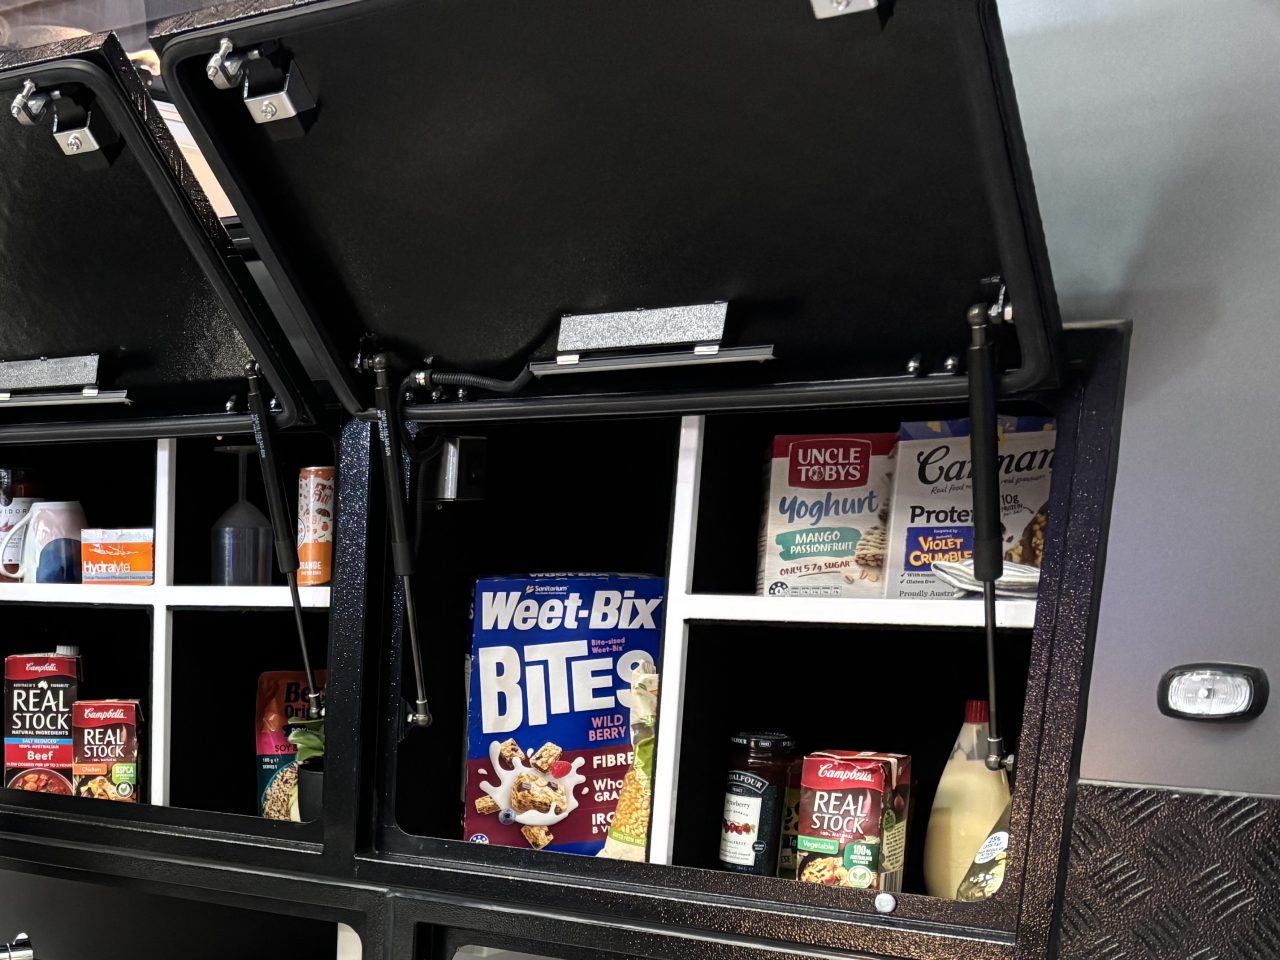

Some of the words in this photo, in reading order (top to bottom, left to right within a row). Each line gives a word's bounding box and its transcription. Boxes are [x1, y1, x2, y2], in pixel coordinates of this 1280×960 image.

[798, 448, 861, 464] UNCLE
[797, 464, 861, 482] TOBYS
[1001, 494, 1019, 504] 10g
[795, 530, 840, 544] MANGO
[918, 536, 963, 551] VIOLET
[790, 541, 853, 554] PASSIONFRUIT
[909, 550, 973, 567] CRUMBLE
[83, 560, 131, 575] Hydralyte
[780, 566, 802, 576] ONLY
[824, 560, 850, 569] SUGAR
[900, 590, 928, 598] Proudly
[482, 590, 661, 630] Weet-Bix
[591, 637, 626, 646] Bite-sized
[591, 645, 623, 654] Weet-Bix
[13, 689, 70, 711] REAL
[12, 713, 69, 730] STOCK
[591, 714, 624, 729] WILD
[84, 728, 124, 745] REAL
[589, 726, 627, 742] BERRY
[27, 750, 54, 761] Beef
[84, 745, 124, 757] STOCK
[275, 744, 290, 752] SOY
[593, 751, 634, 769] FIBRE
[115, 766, 134, 774] RSPCA
[813, 791, 867, 817] REAL
[811, 813, 865, 834] STOCK
[803, 840, 834, 850] Vegetable
[853, 845, 871, 855] 100%
